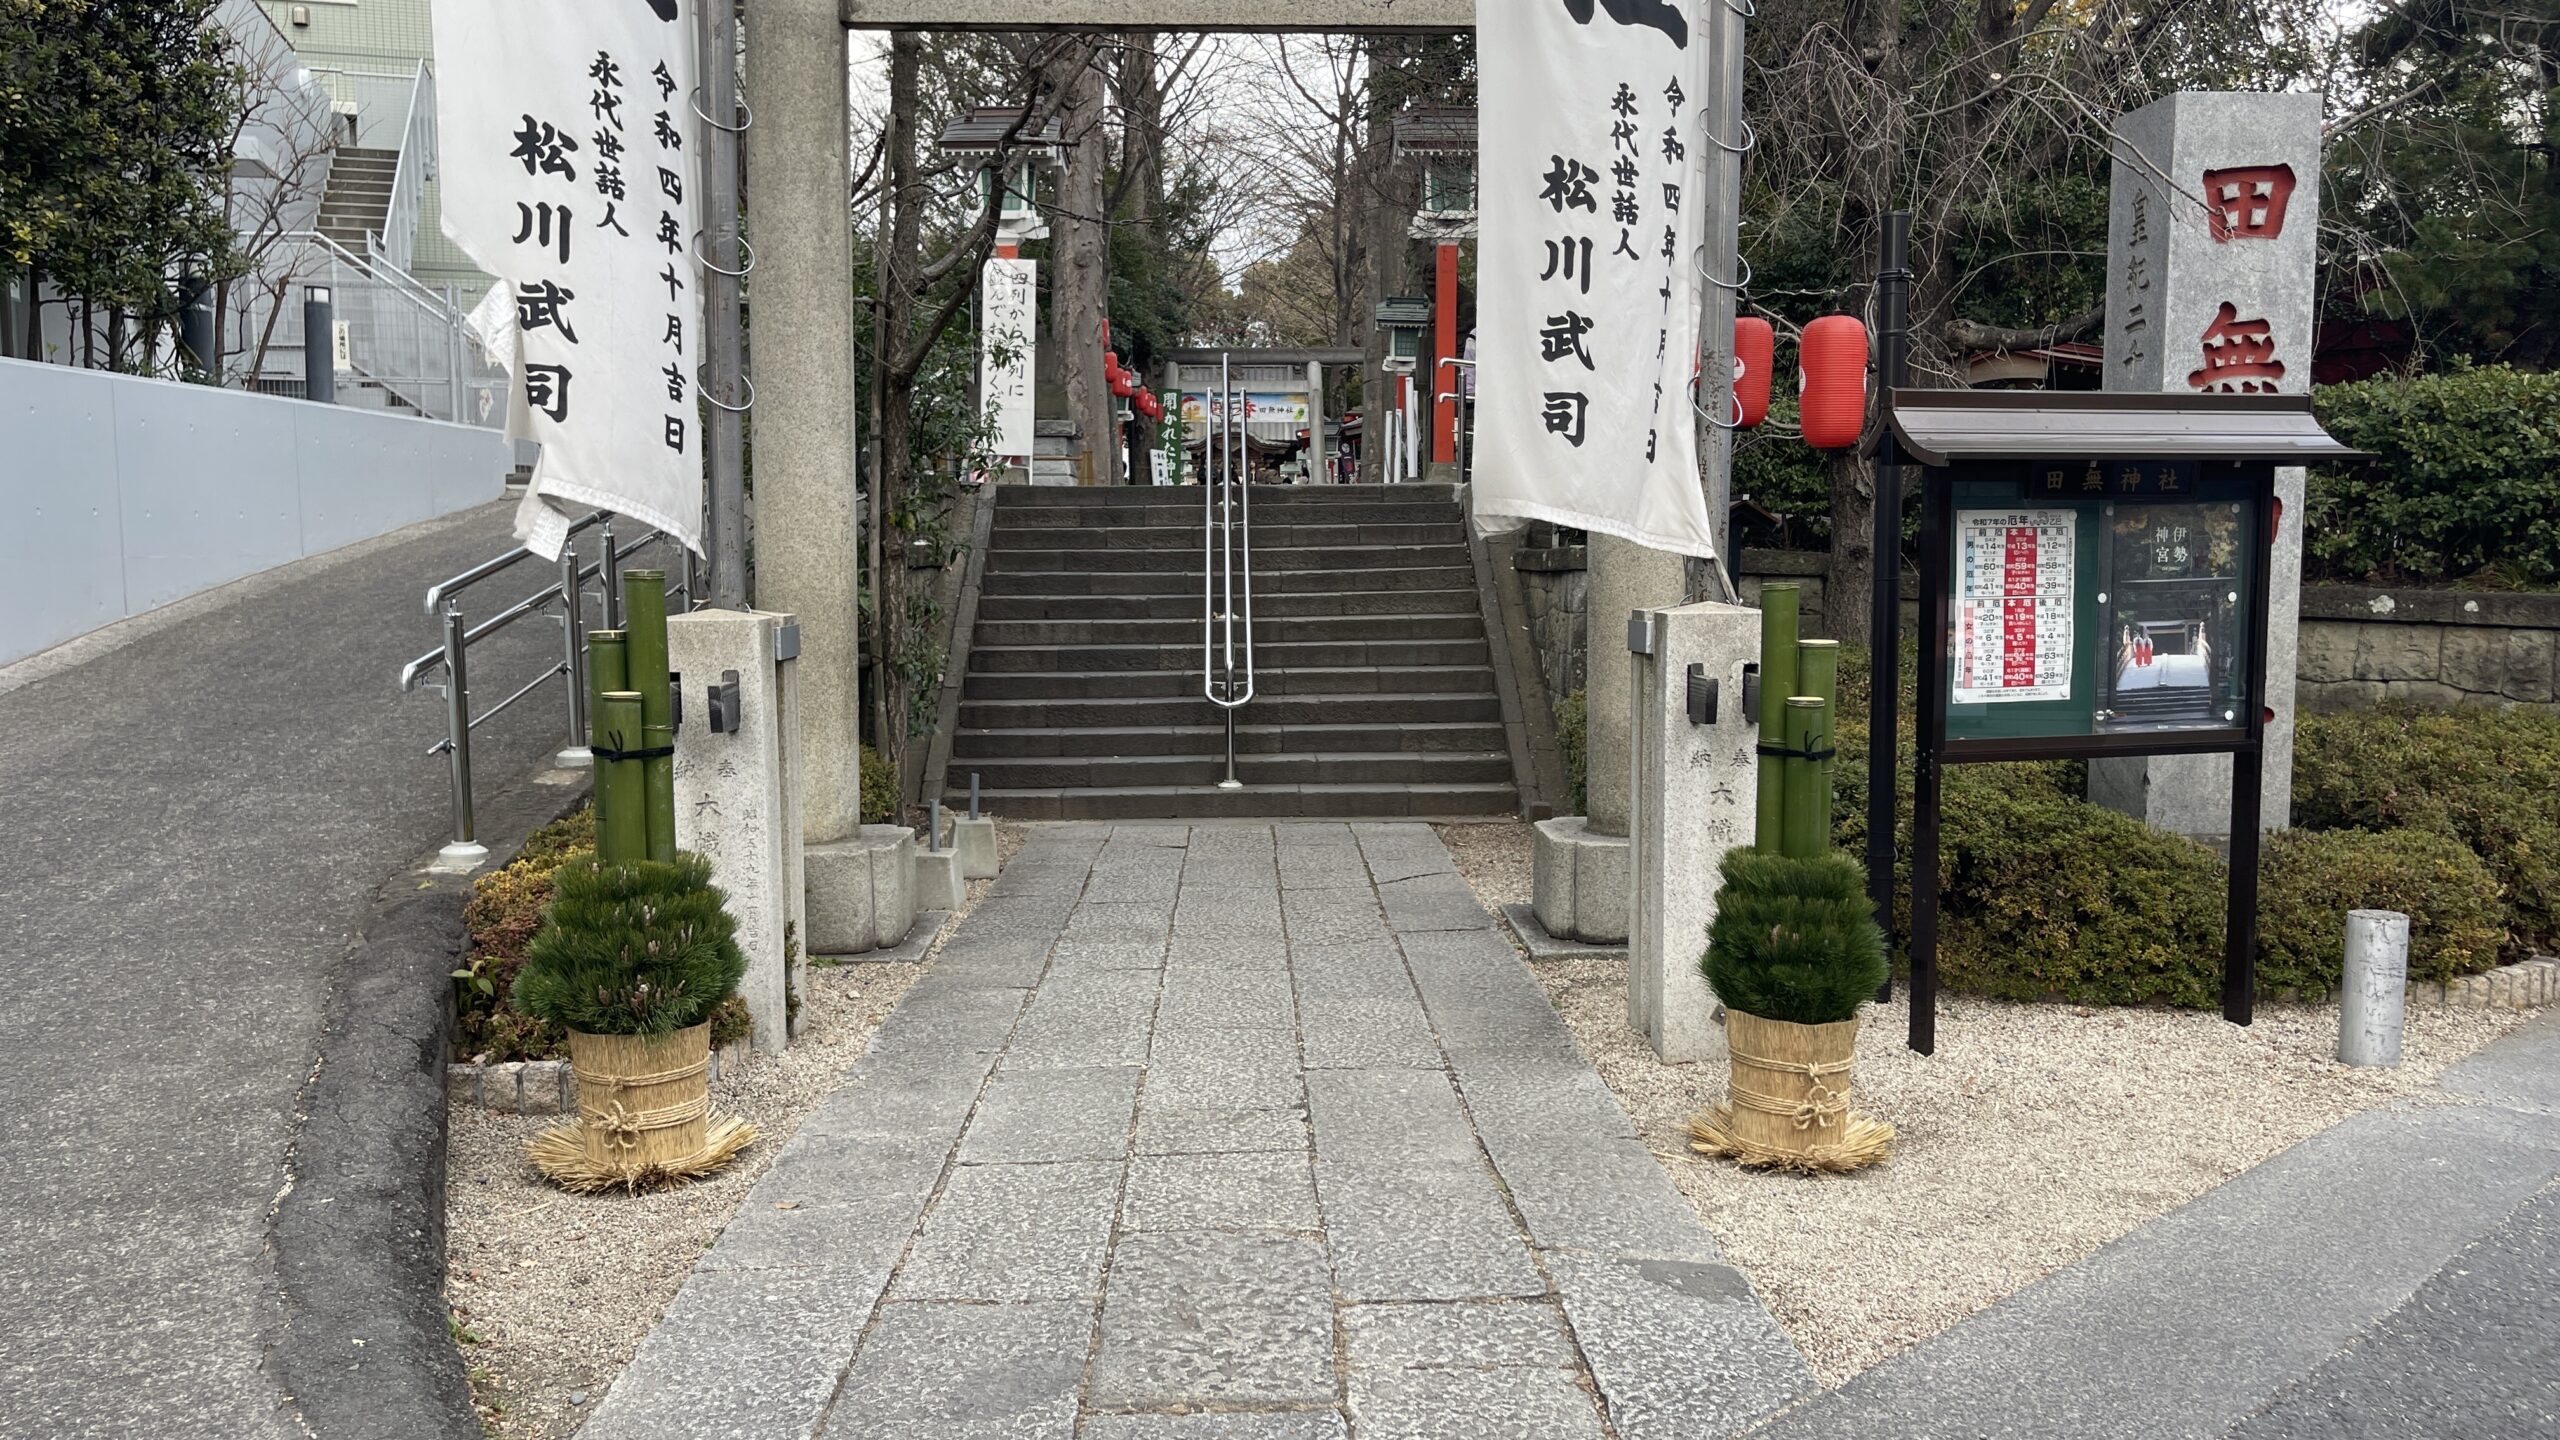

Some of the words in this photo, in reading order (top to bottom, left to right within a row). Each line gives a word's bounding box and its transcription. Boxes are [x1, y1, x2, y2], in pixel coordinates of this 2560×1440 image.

[588, 49, 630, 238] 永代世話人
[651, 58, 686, 455] 令和四年十月吉日
[1610, 81, 1640, 262] 永代世話人
[510, 114, 580, 424] 松川武司
[1538, 154, 1600, 448] 松川武司
[2047, 467, 2178, 492] 田無神社
